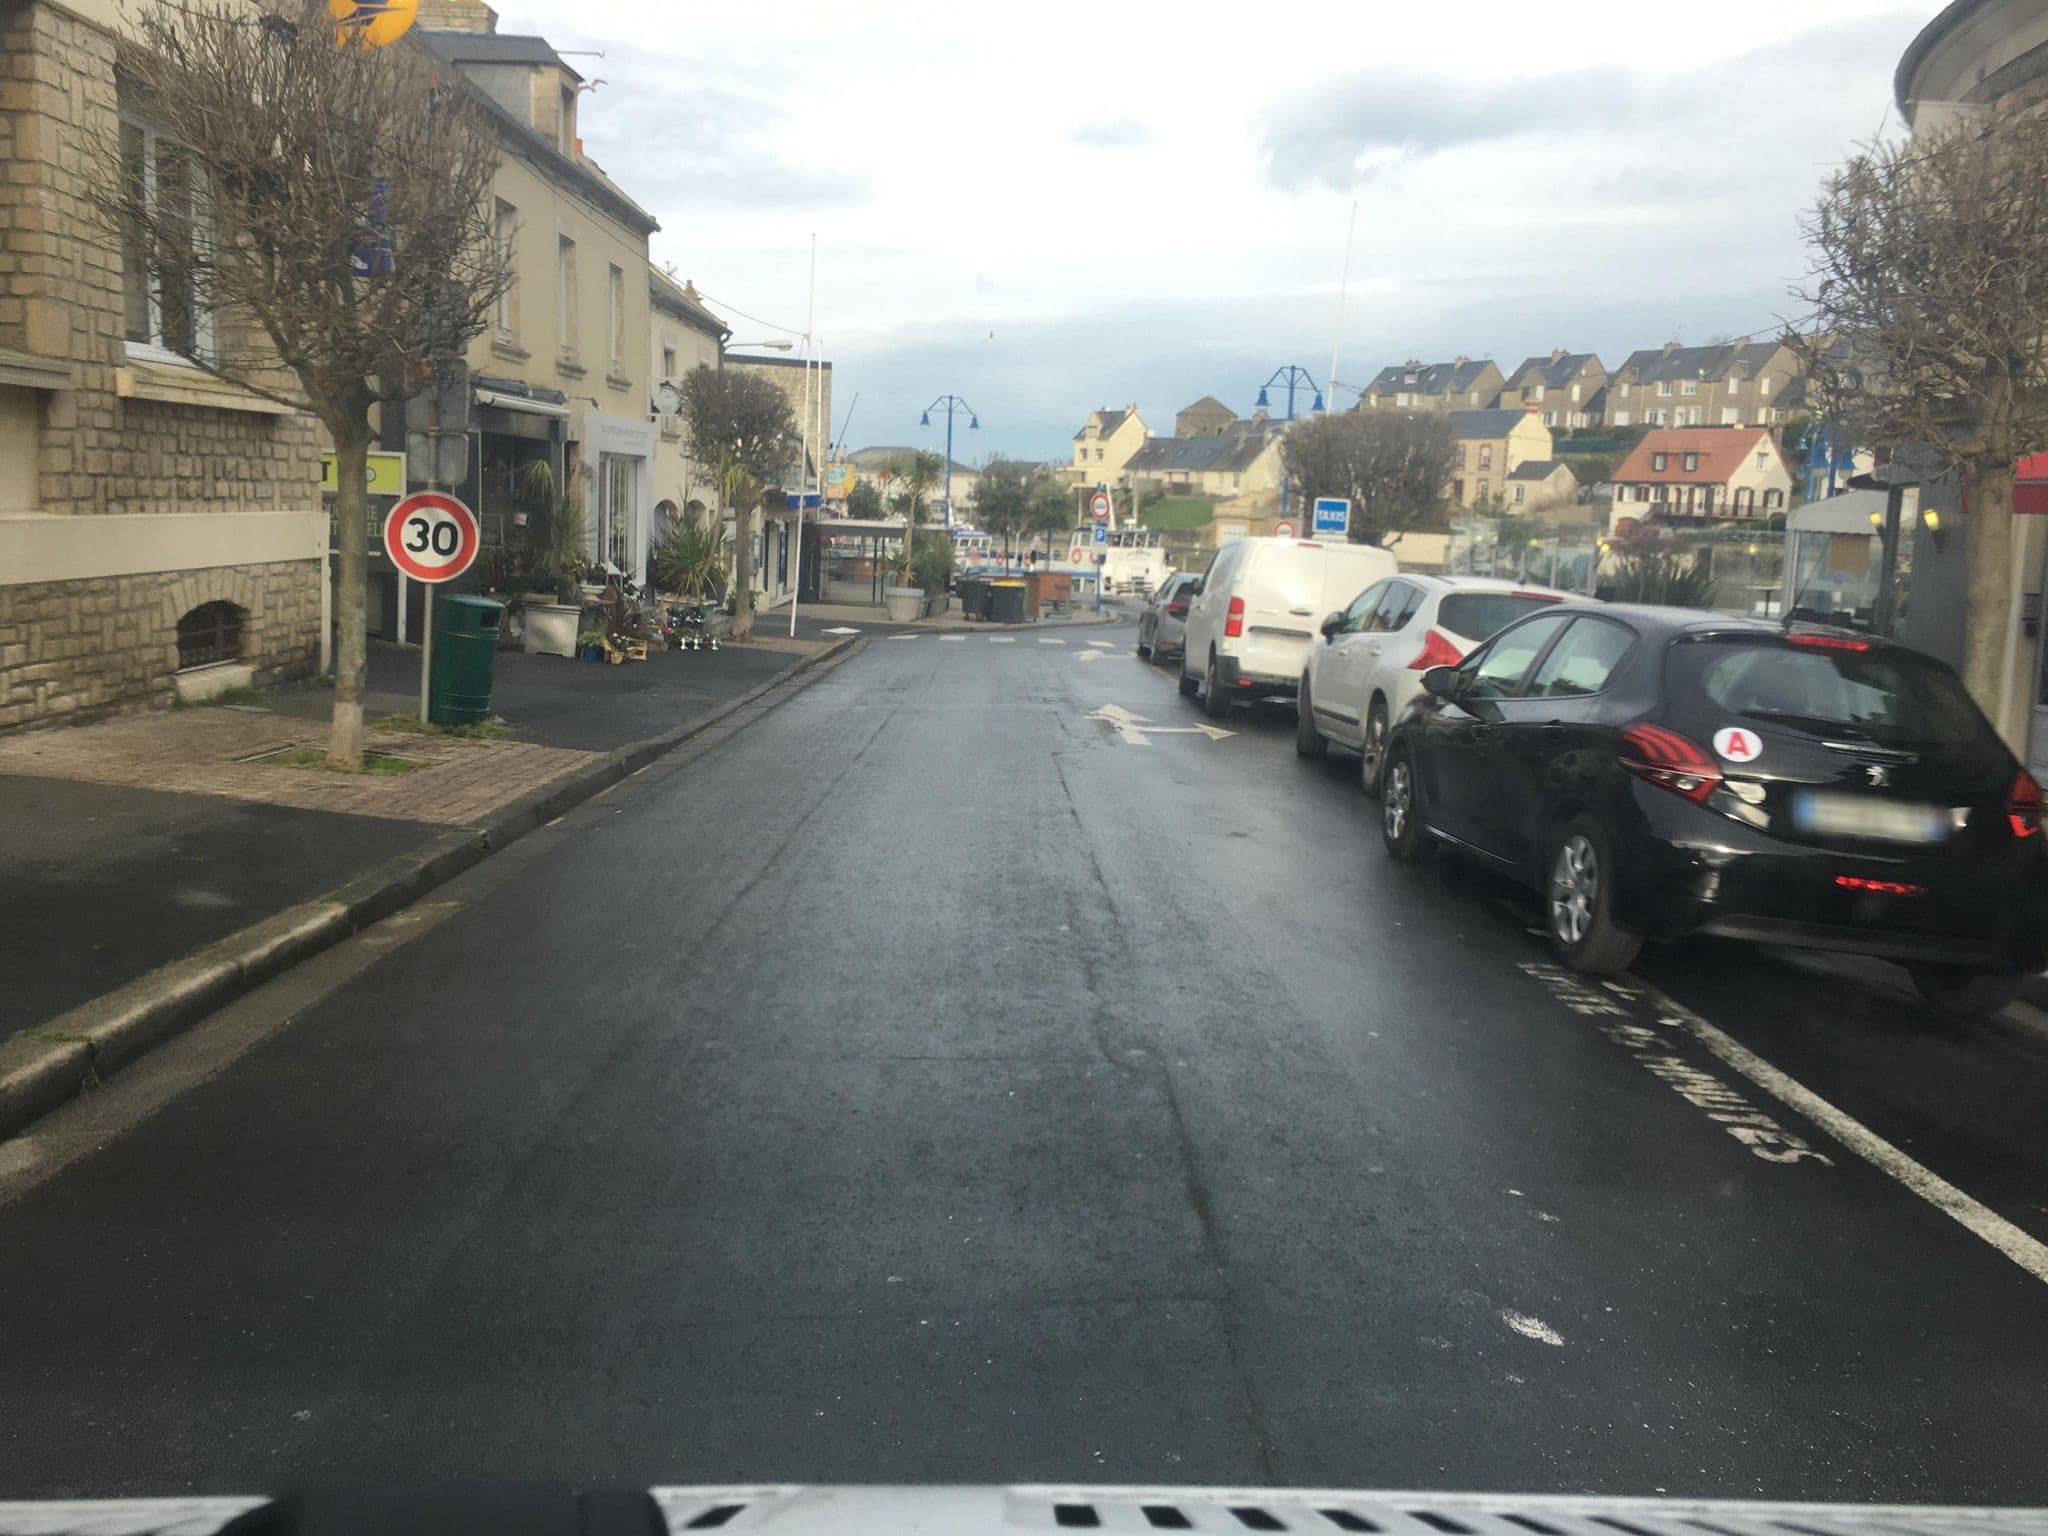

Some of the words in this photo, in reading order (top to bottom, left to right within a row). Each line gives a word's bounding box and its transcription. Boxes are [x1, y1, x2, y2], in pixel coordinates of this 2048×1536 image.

[1318, 509, 1346, 523] TAXIS
[406, 517, 459, 557] 30
[1726, 731, 1750, 757] A
